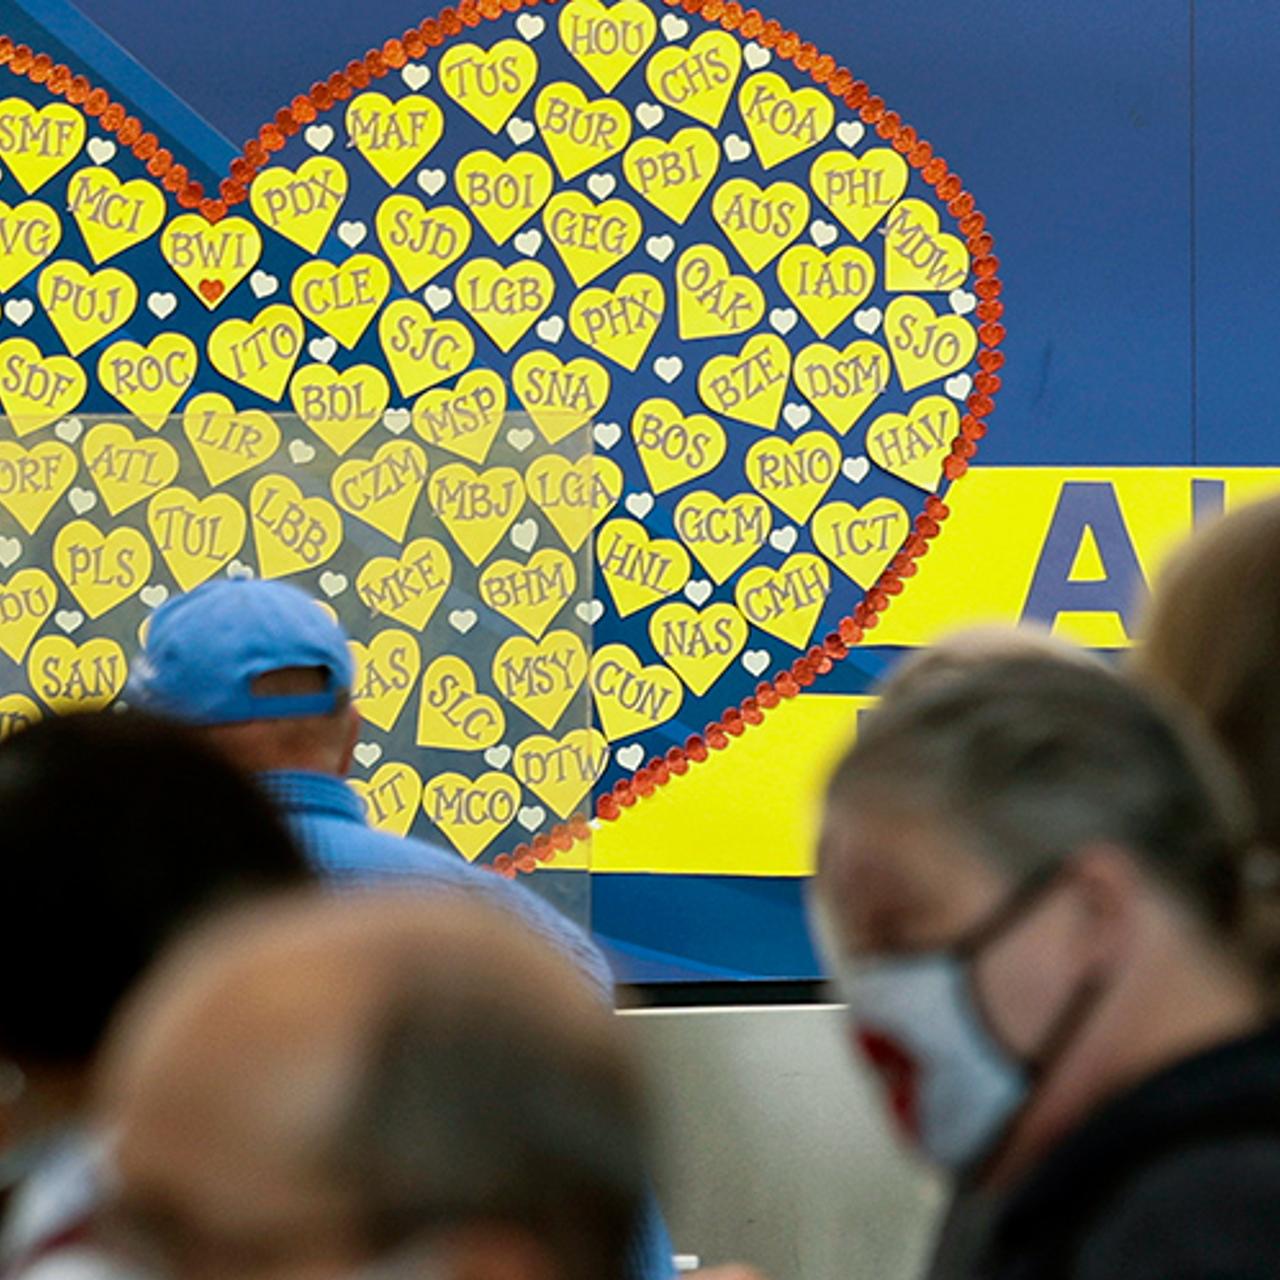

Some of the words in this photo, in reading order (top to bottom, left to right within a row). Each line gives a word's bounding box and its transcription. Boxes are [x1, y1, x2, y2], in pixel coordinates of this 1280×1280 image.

[570, 15, 646, 56] HOU
[446, 56, 523, 98] TUS
[659, 46, 731, 103] CHS
[0, 114, 77, 157] SMF
[347, 109, 430, 149] MAF
[543, 97, 618, 152] BUR
[745, 85, 819, 144] KOA
[466, 171, 534, 208] BOI
[634, 145, 703, 194] PBI
[825, 169, 897, 208] PHL
[67, 176, 143, 233] MCI
[262, 169, 343, 226] PDX
[721, 194, 796, 237] AUS
[0, 218, 51, 256] VG
[169, 231, 246, 268] BWI
[390, 209, 458, 260] SJD
[551, 206, 627, 255] GEG
[877, 205, 966, 291] MDW
[48, 274, 121, 324] PUJ
[304, 268, 375, 314] CLE
[468, 275, 543, 314] LGB
[682, 256, 753, 329] OAK
[797, 261, 867, 298] IAD
[581, 288, 662, 346] PHX
[894, 314, 960, 367] SJO
[230, 323, 298, 380] ITO
[390, 316, 460, 371] SJC
[3, 355, 74, 407] SDF
[111, 351, 190, 395] ROC
[525, 367, 597, 413] SNA
[709, 346, 785, 411] BZE
[804, 356, 887, 398] DSM
[302, 384, 376, 422] BDL
[421, 386, 497, 443] MSP
[195, 409, 263, 459] LIR
[637, 414, 711, 470] BOS
[875, 410, 951, 470] HAV
[90, 443, 164, 487] ATL
[340, 446, 428, 511] CZM
[757, 448, 833, 489] RNO
[432, 478, 515, 520] MBJ
[537, 470, 613, 510] LGA
[154, 504, 228, 562] TUL
[255, 487, 329, 564] LBB
[680, 504, 768, 545] GCM
[831, 513, 899, 557] ICT
[67, 543, 135, 590] PLS
[362, 550, 446, 617] MKE
[483, 562, 571, 607] BHM
[601, 532, 674, 596] HNL
[0, 588, 50, 622] DU
[744, 563, 831, 623] CMH
[660, 616, 734, 658] NAS
[42, 655, 118, 700] SAN
[353, 648, 410, 700] AS
[501, 649, 577, 699] MSY
[594, 660, 672, 721] CUN
[428, 674, 496, 740] SLC
[520, 746, 609, 785] DTW
[367, 773, 405, 823] IT
[433, 786, 514, 824] MCO
